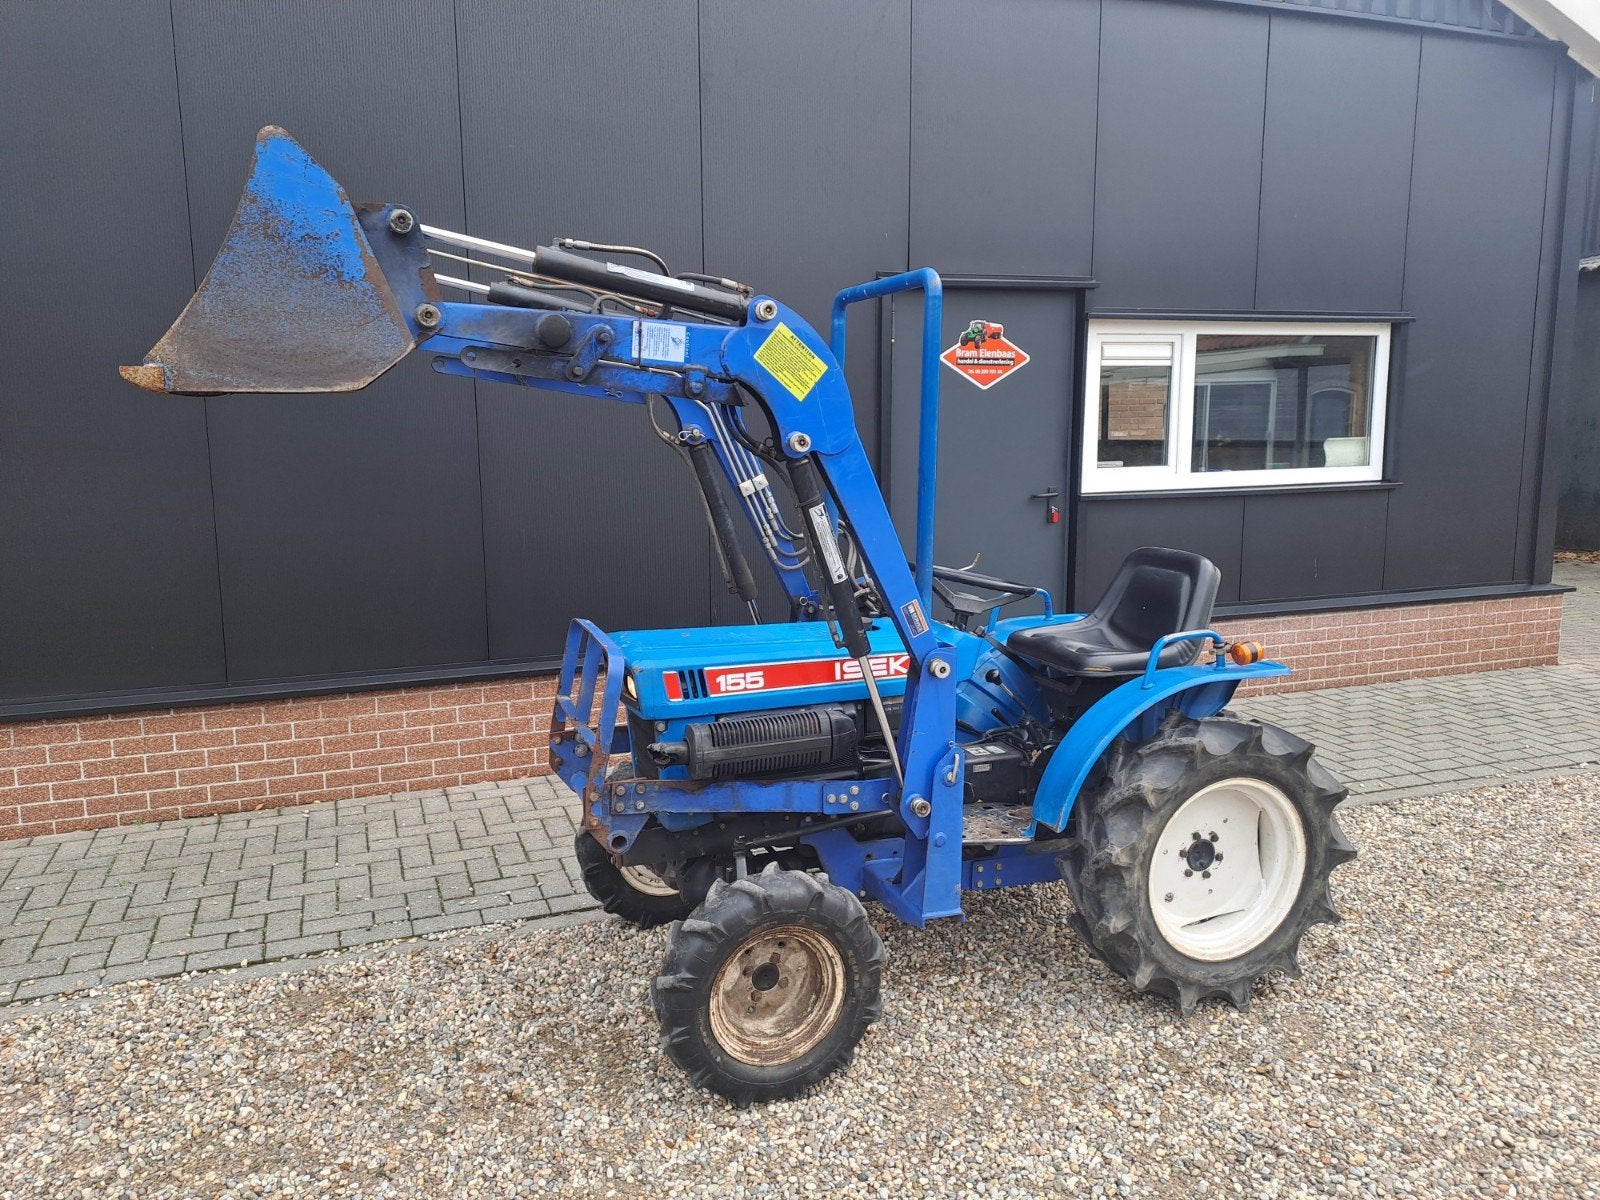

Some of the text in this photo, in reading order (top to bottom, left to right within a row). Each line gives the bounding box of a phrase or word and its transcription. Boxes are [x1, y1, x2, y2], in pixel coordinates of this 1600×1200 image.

[790, 335, 816, 360] ATTENTION
[956, 349, 1015, 358] Bram Elenbaas
[715, 671, 765, 692] 155
